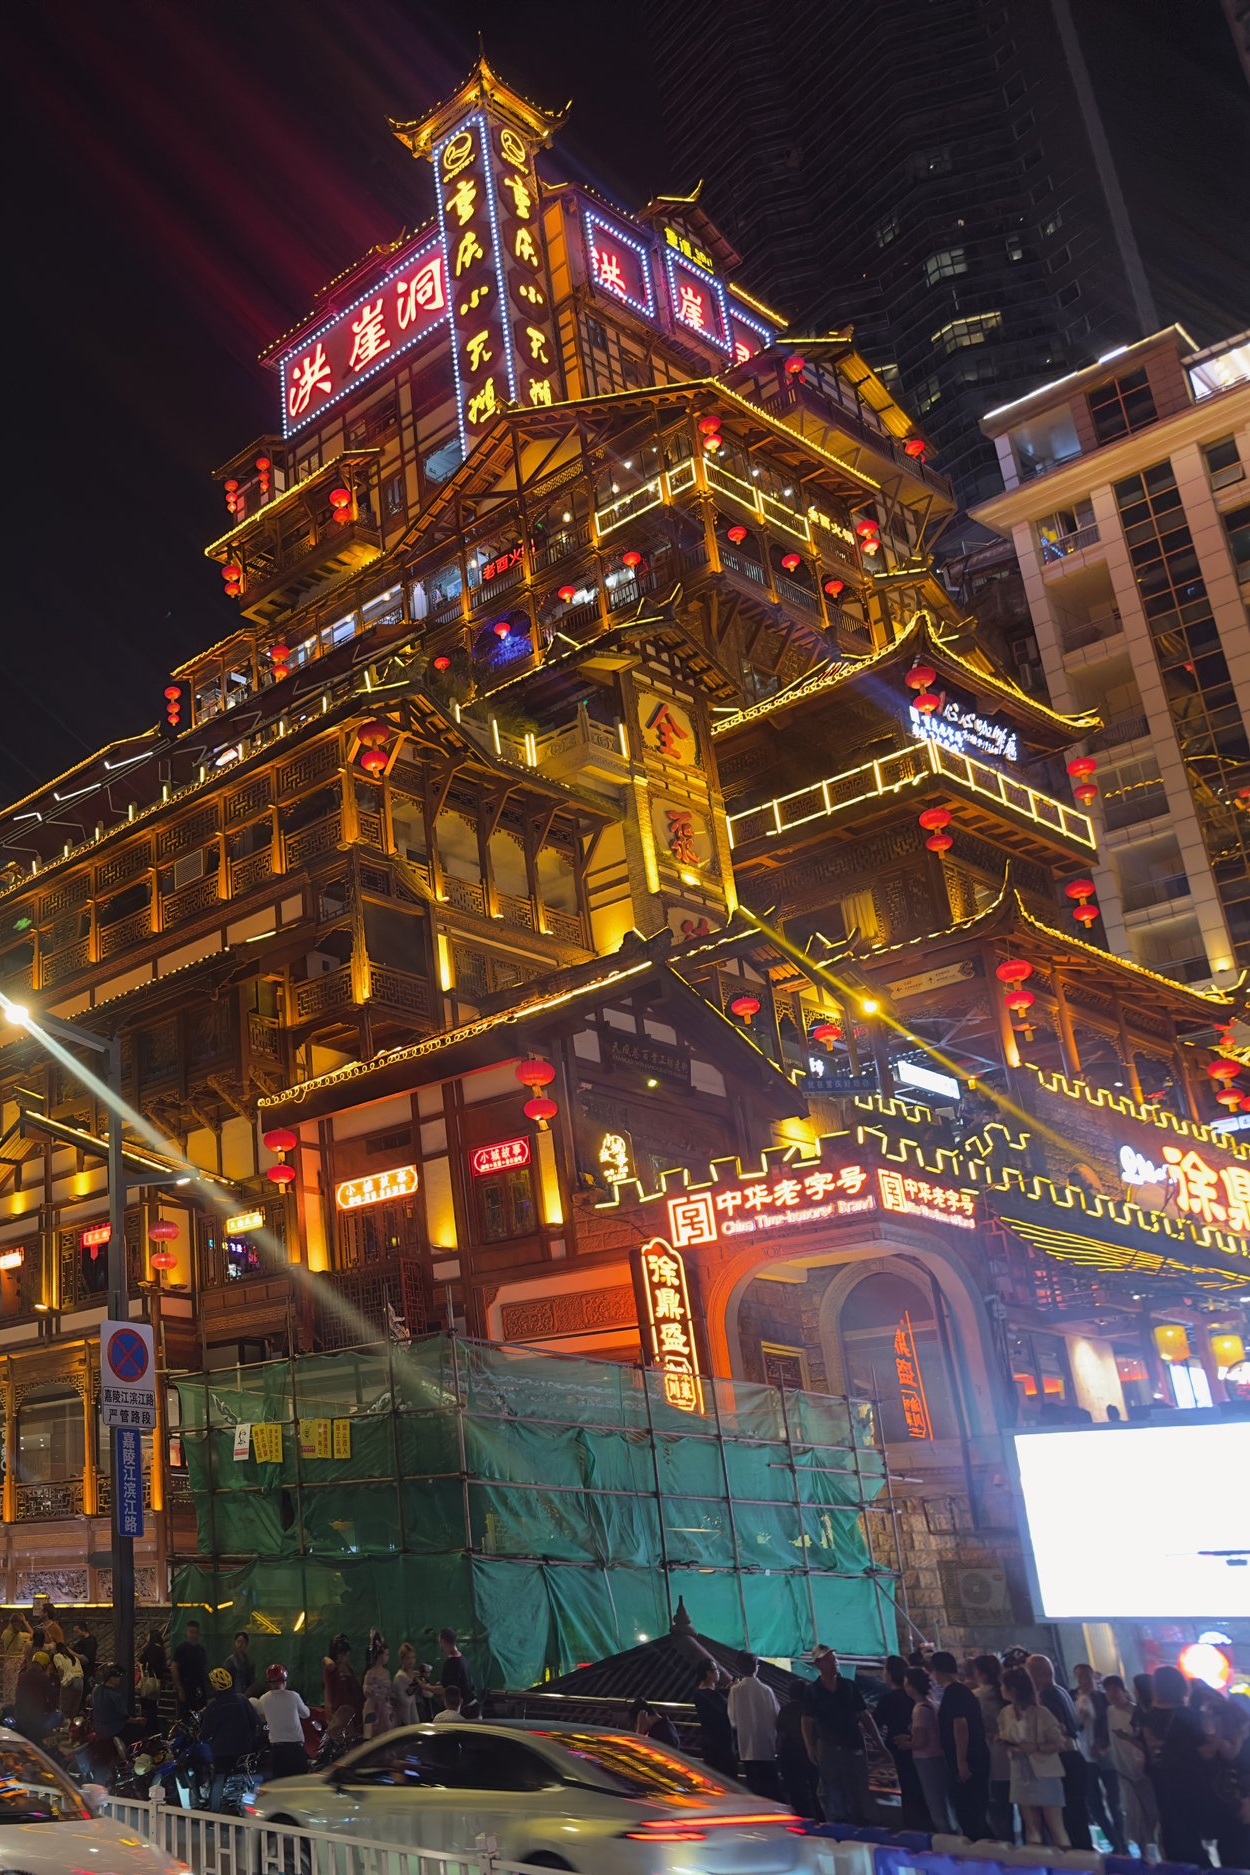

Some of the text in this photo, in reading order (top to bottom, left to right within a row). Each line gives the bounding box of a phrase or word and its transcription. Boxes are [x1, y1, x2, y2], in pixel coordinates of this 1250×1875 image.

[289, 256, 447, 417] 洪崖洞
[446, 180, 498, 424] 重庆小天鹅
[716, 1166, 867, 1217] 中华老字号
[904, 1179, 975, 1215] 中华老字号
[648, 1254, 690, 1354] 徐鼎盛
[104, 1389, 154, 1407] 嘉陵江滨江路
[108, 1409, 152, 1425] 严管路段
[122, 1432, 137, 1533] 嘉陵江滨江路
